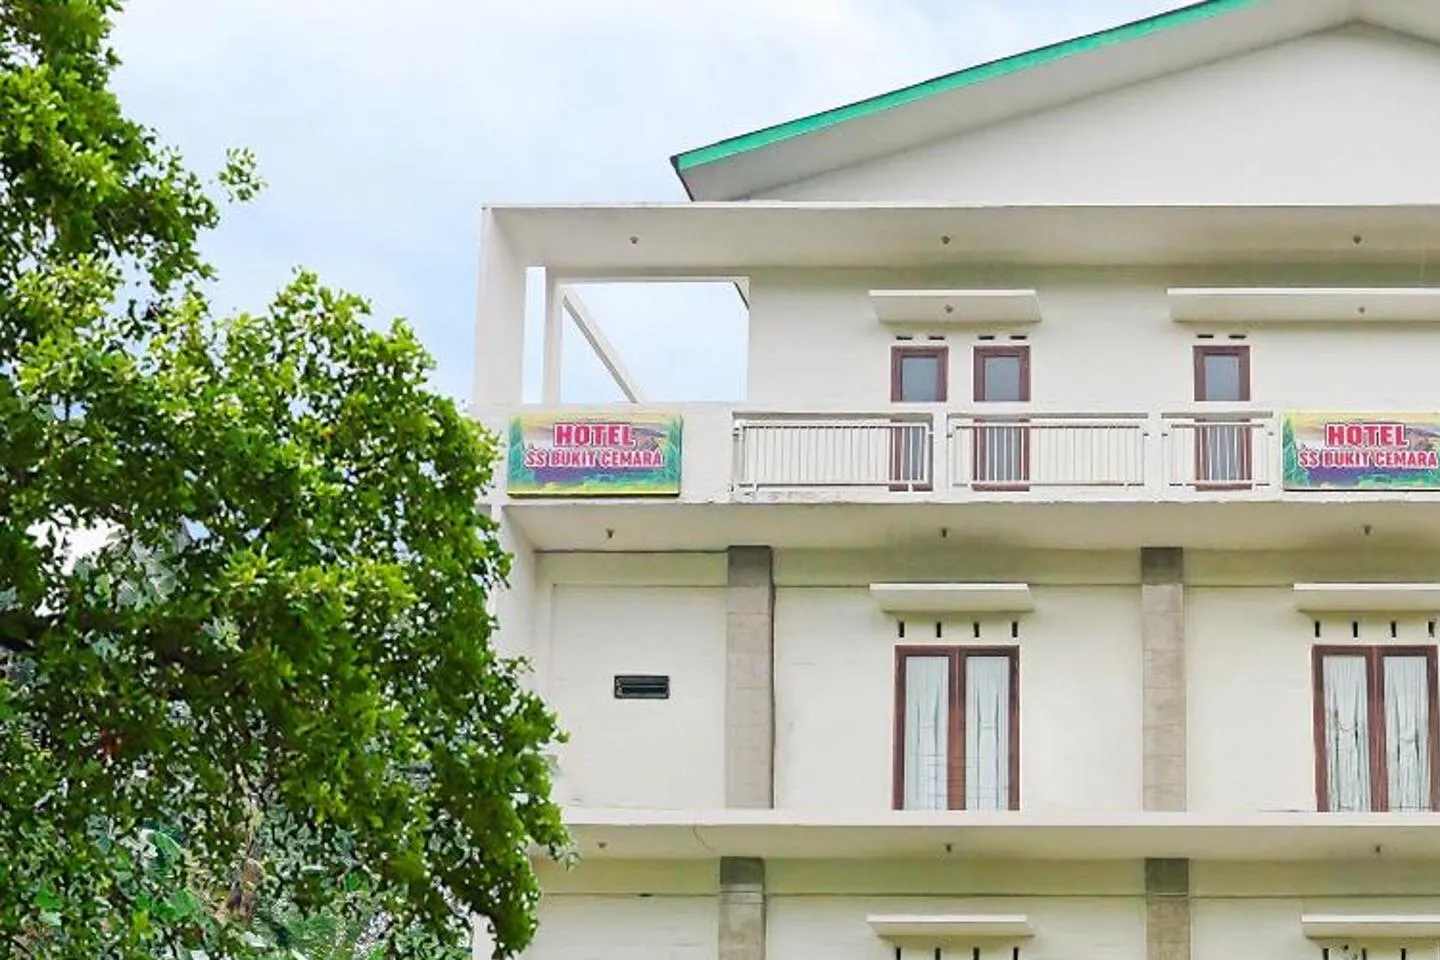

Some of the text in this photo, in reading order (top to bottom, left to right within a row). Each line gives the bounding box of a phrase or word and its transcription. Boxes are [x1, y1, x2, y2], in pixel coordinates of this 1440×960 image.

[554, 423, 636, 446] HOTEL
[1326, 423, 1409, 447] HOTEL
[525, 450, 664, 467] SS BUKIT CEMARA
[1298, 451, 1439, 468] SS BUKIT CEMARA
